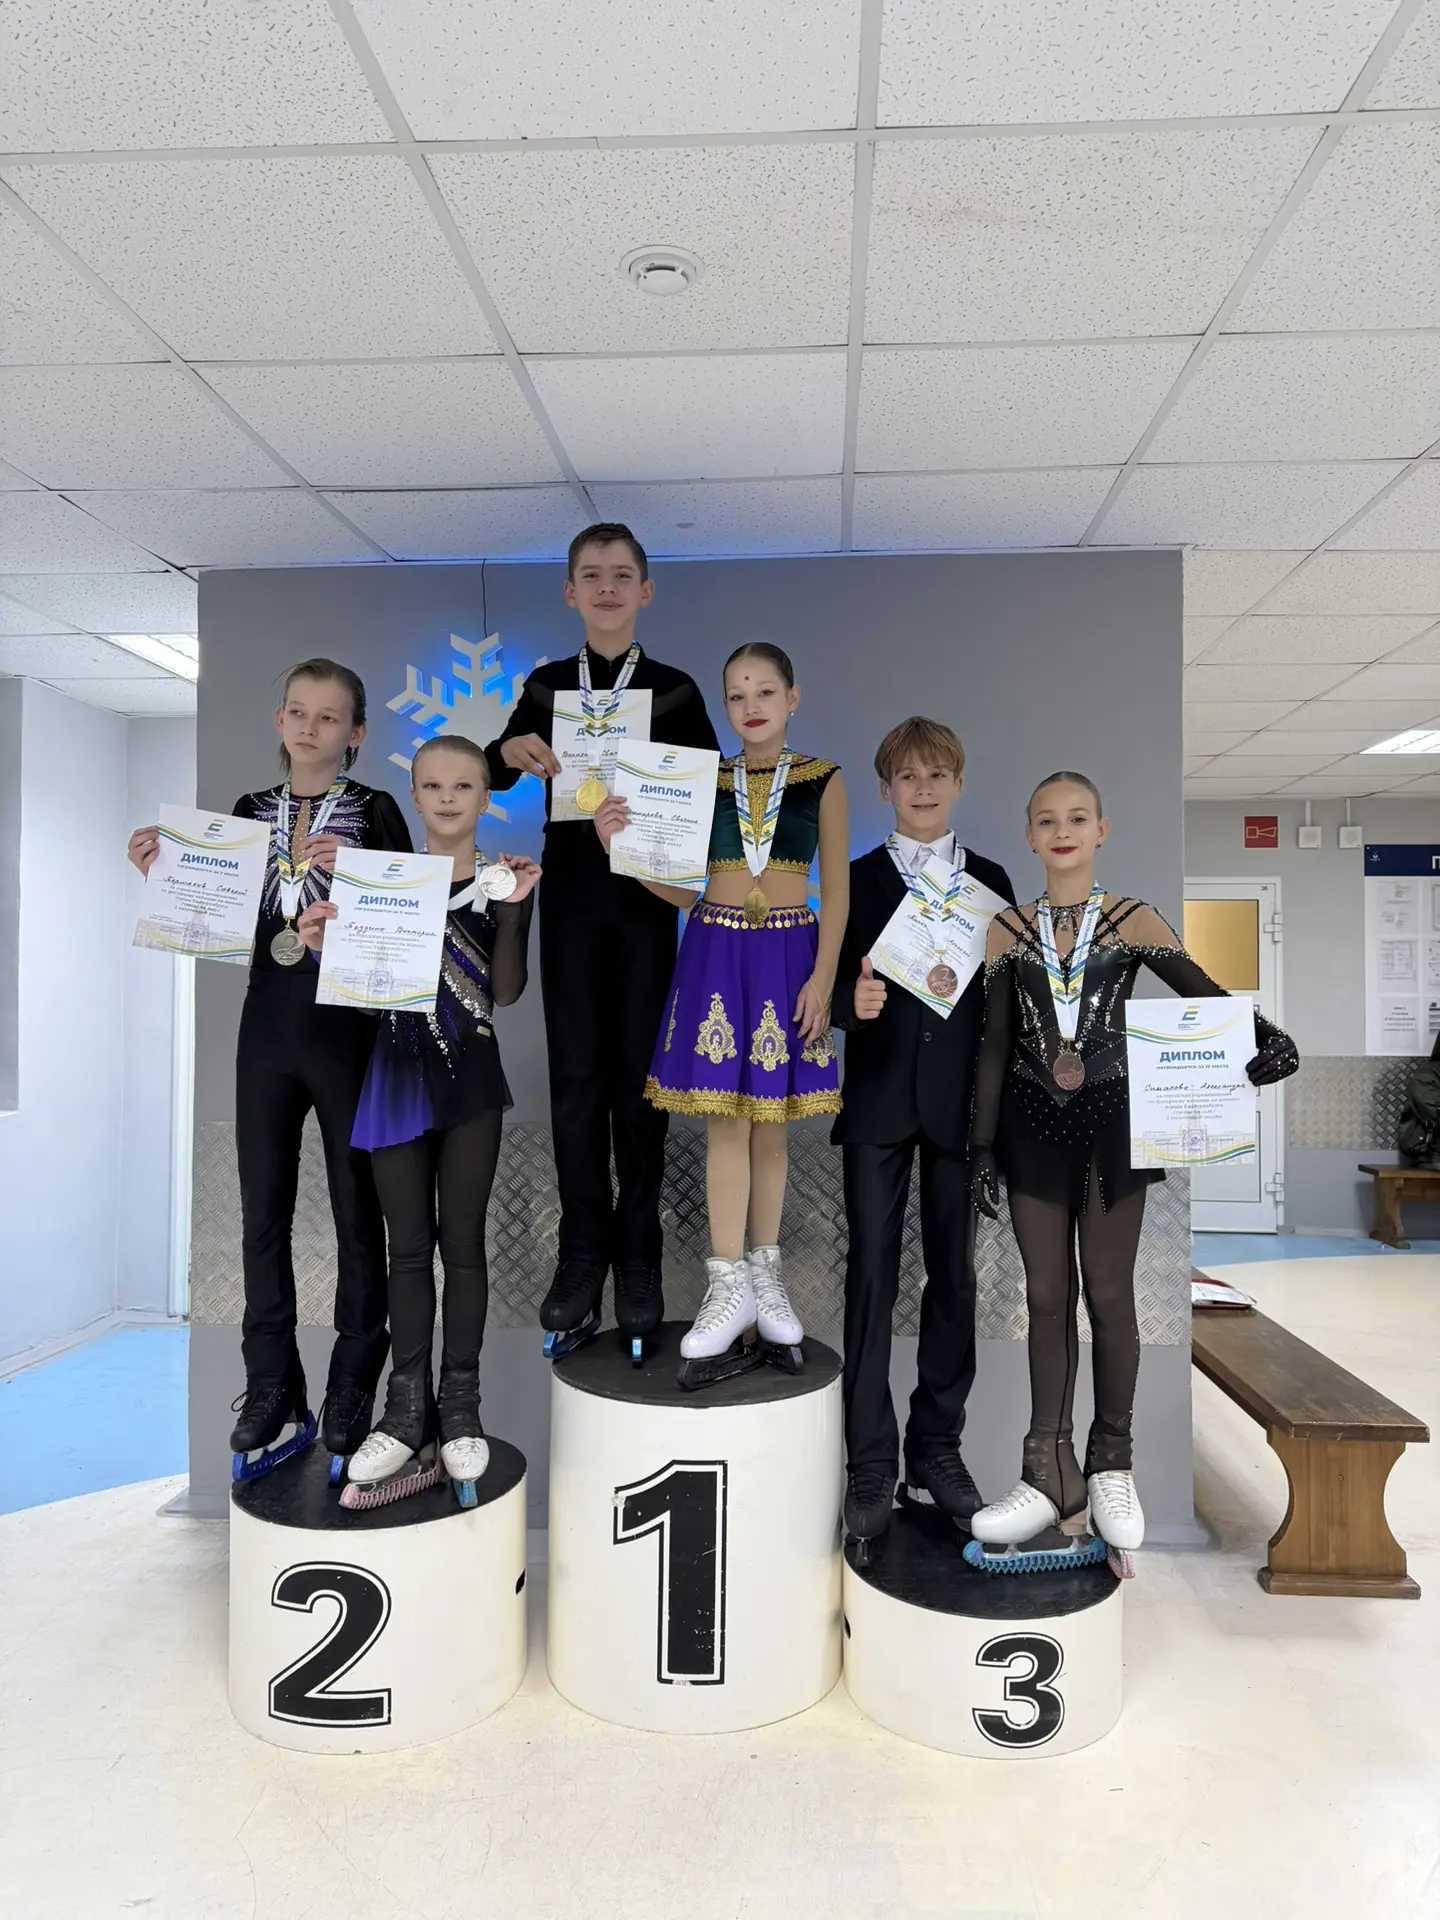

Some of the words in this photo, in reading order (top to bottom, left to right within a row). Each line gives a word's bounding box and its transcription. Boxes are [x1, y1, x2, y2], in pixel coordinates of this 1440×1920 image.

[576, 726, 627, 737] ДОМ
[640, 784, 692, 799] ДИПЛОМ
[180, 852, 239, 871] ДИПЛОМ
[358, 894, 420, 909] ДИПЛОМ
[930, 900, 975, 932] ДИЛОМ
[1160, 1050, 1226, 1063] ДИПЛОМ
[613, 1459, 728, 1685] 1
[269, 1562, 391, 1728] 2
[972, 1632, 1065, 1749] 3
